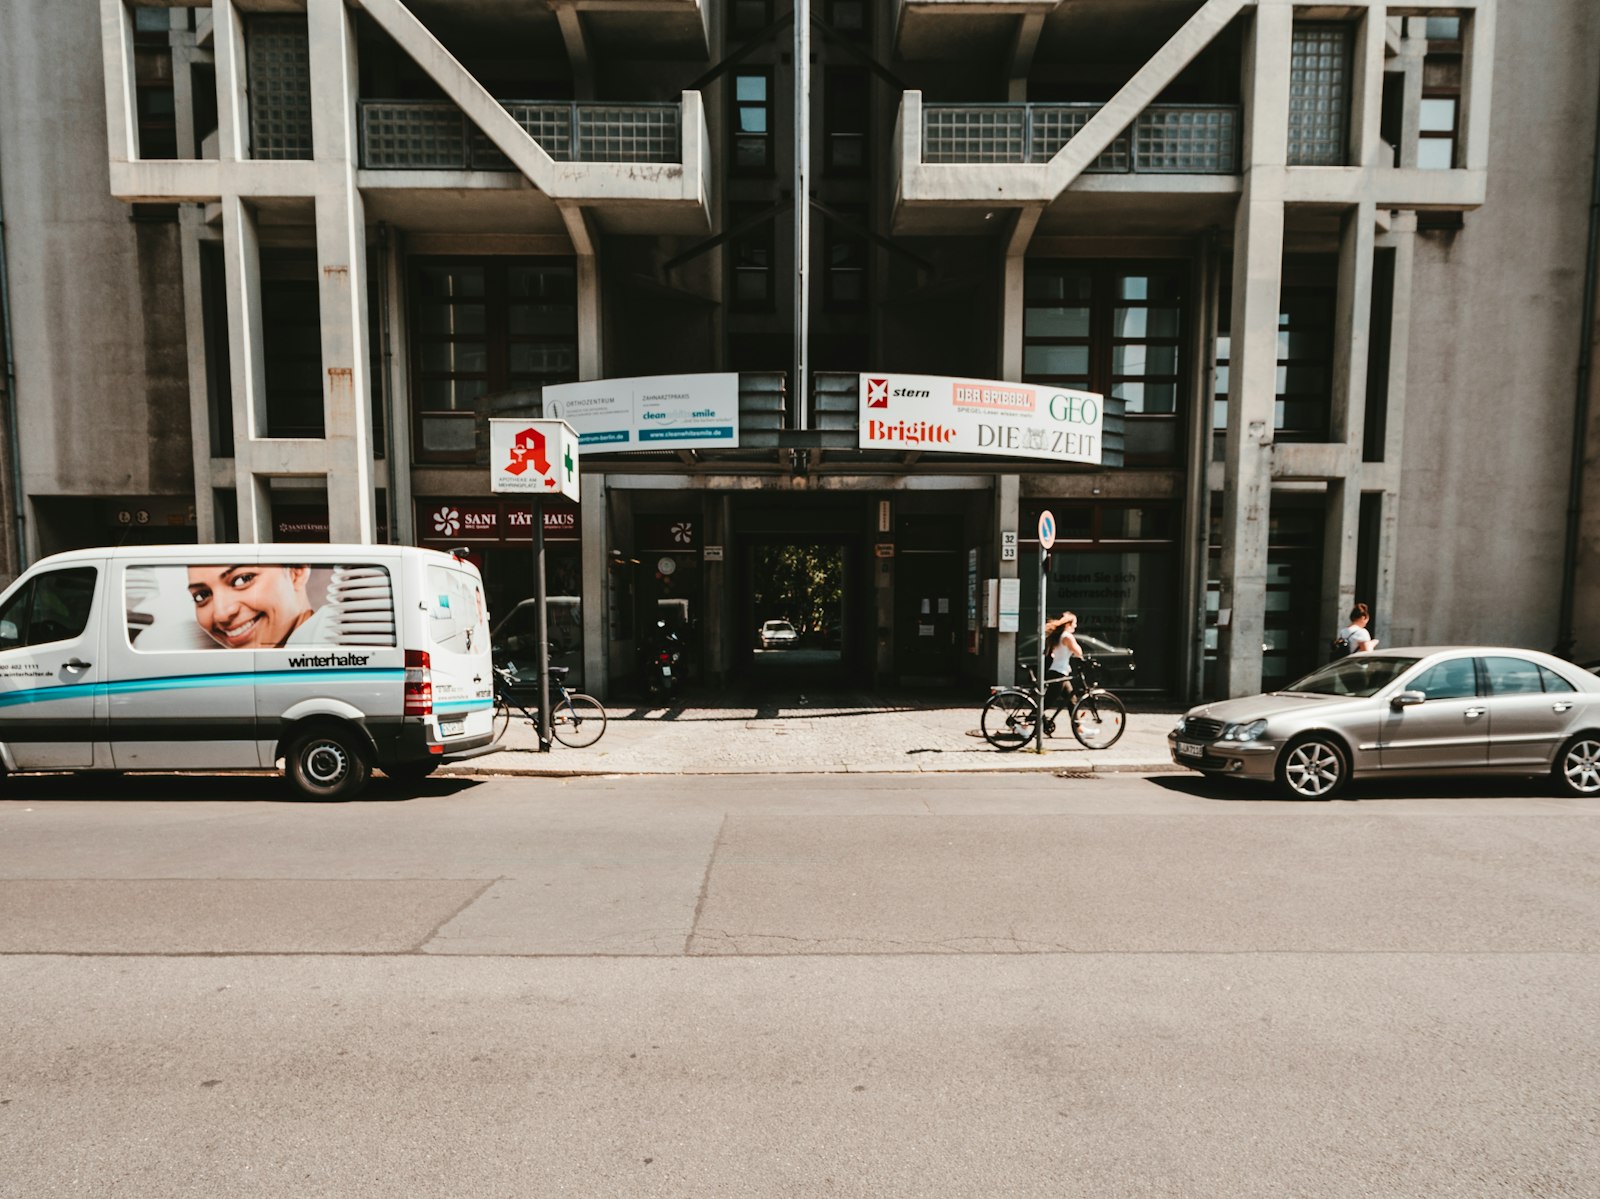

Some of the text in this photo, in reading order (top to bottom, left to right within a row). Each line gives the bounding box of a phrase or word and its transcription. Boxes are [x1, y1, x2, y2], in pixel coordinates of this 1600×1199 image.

[893, 388, 930, 398] stern
[957, 388, 1032, 407] DER SPIEGEL
[566, 397, 615, 407] ORTHOZENTRUM
[1049, 394, 1098, 425] GEO
[869, 420, 957, 447] Brigitte
[978, 424, 1096, 456] DIE ZEIT
[1005, 535, 1014, 544] 32
[1004, 548, 1014, 557] 33
[1094, 572, 1111, 583] Sie
[1114, 572, 1136, 583] sich
[288, 652, 370, 667] winterhalter
